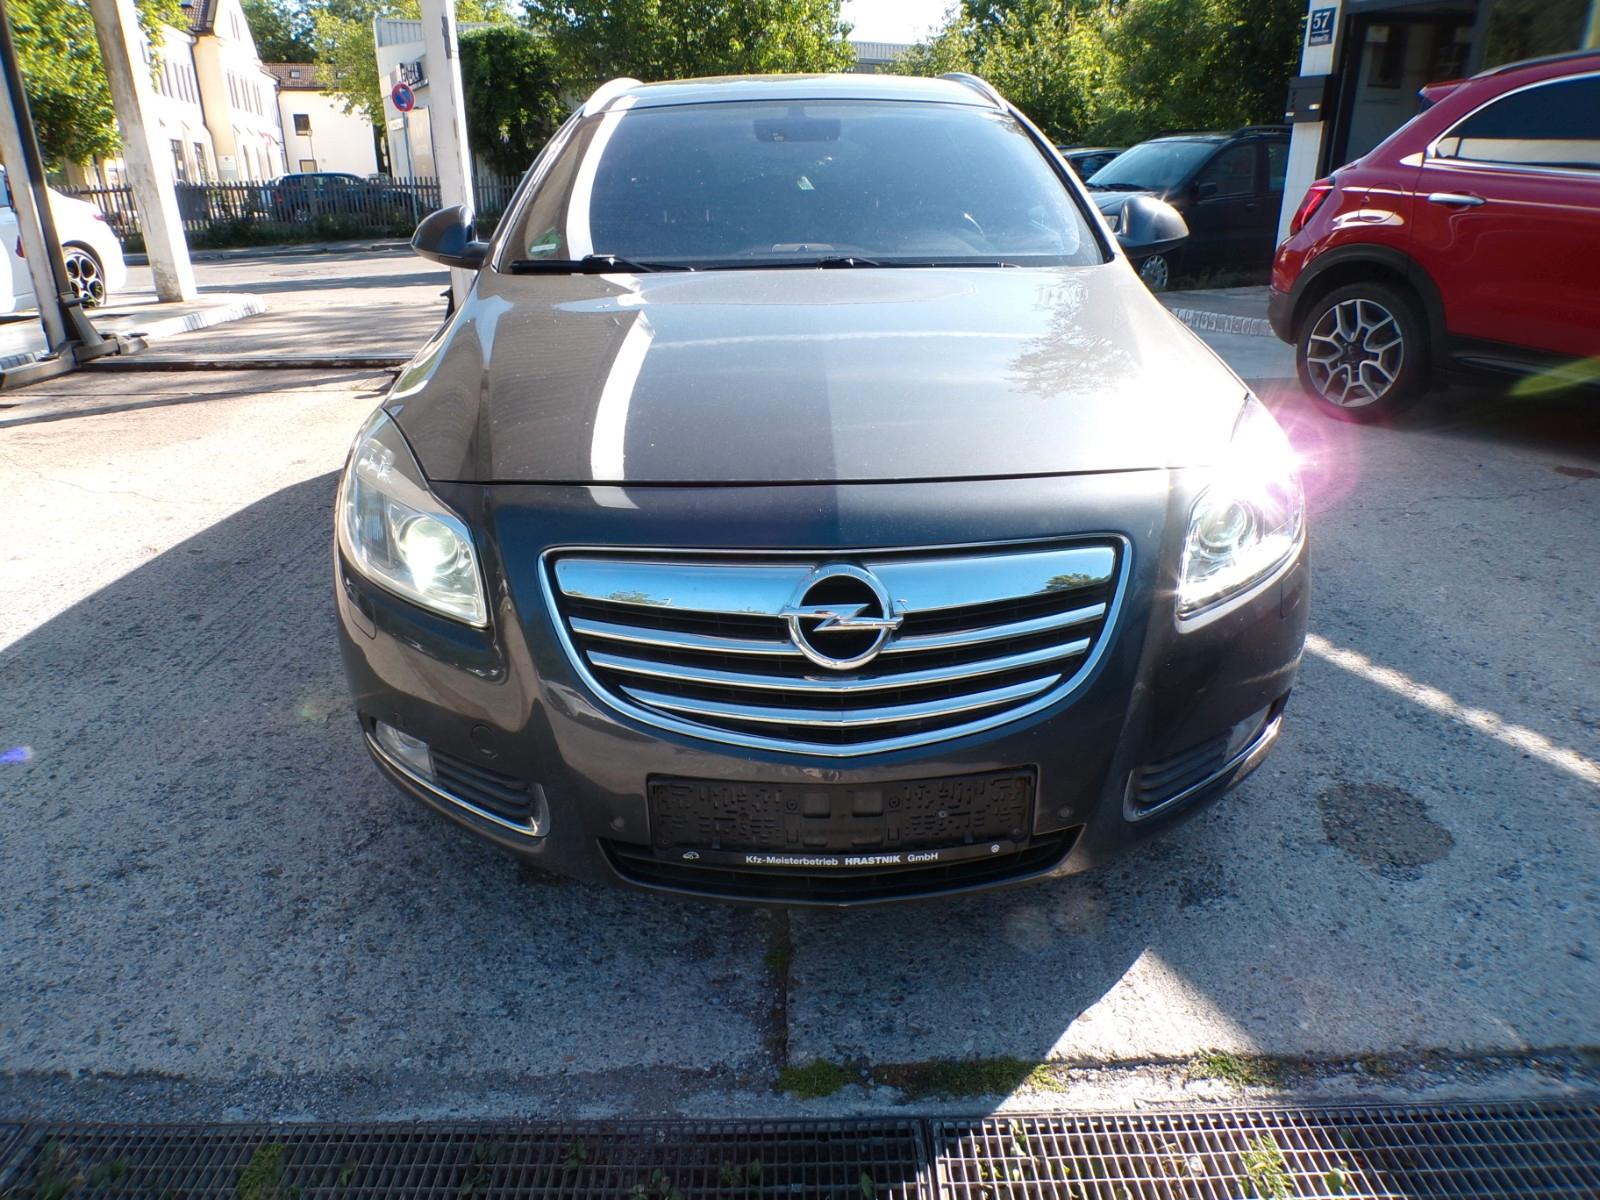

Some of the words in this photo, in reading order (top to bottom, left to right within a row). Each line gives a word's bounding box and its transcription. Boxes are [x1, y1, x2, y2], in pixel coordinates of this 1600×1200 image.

[1312, 11, 1331, 30] 57
[745, 855, 839, 866] Kfz-Meisterbetrieb
[844, 855, 901, 866] HRASTNIK
[907, 852, 939, 863] GmbH
